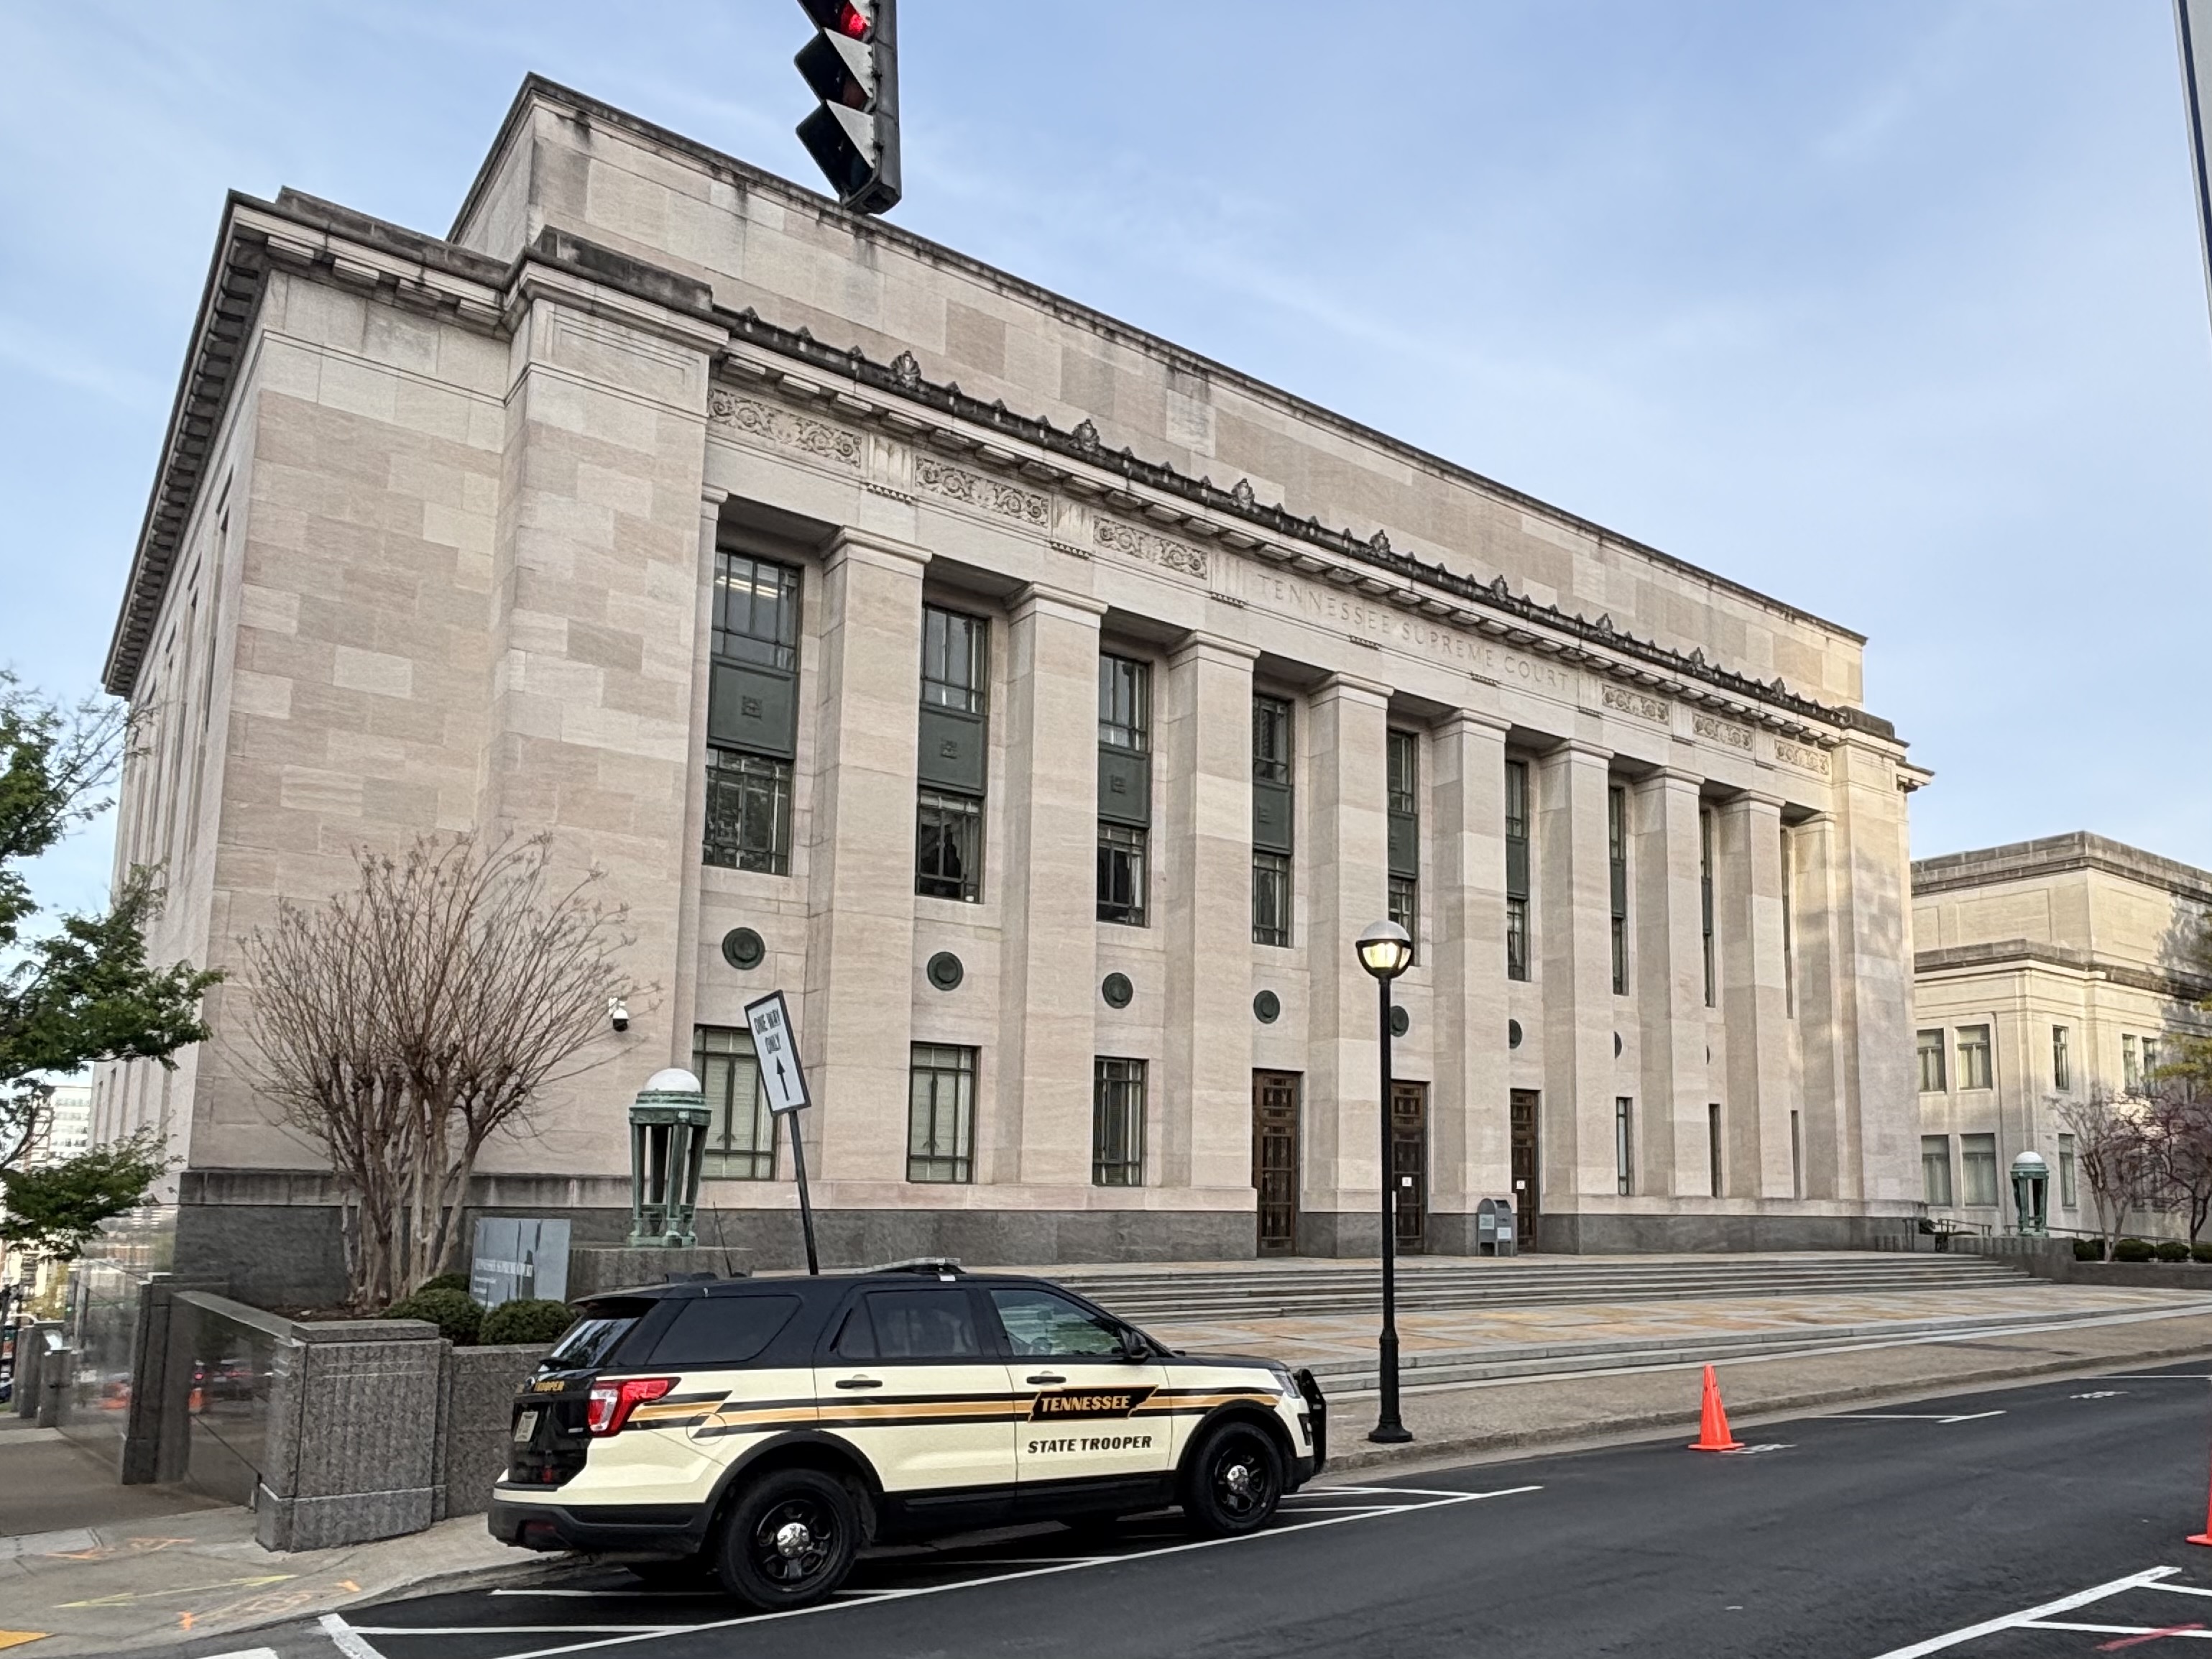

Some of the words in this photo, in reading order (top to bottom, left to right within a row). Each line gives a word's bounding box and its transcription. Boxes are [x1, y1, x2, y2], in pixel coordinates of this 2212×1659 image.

[1257, 574, 1391, 634] TENNESSEE
[1401, 622, 1494, 668] SUPREME
[1504, 655, 1568, 691] COURT
[1041, 1395, 1131, 1412] TENNESSEE
[1028, 1438, 1077, 1454] STATE
[1080, 1435, 1153, 1451] TROOPER
